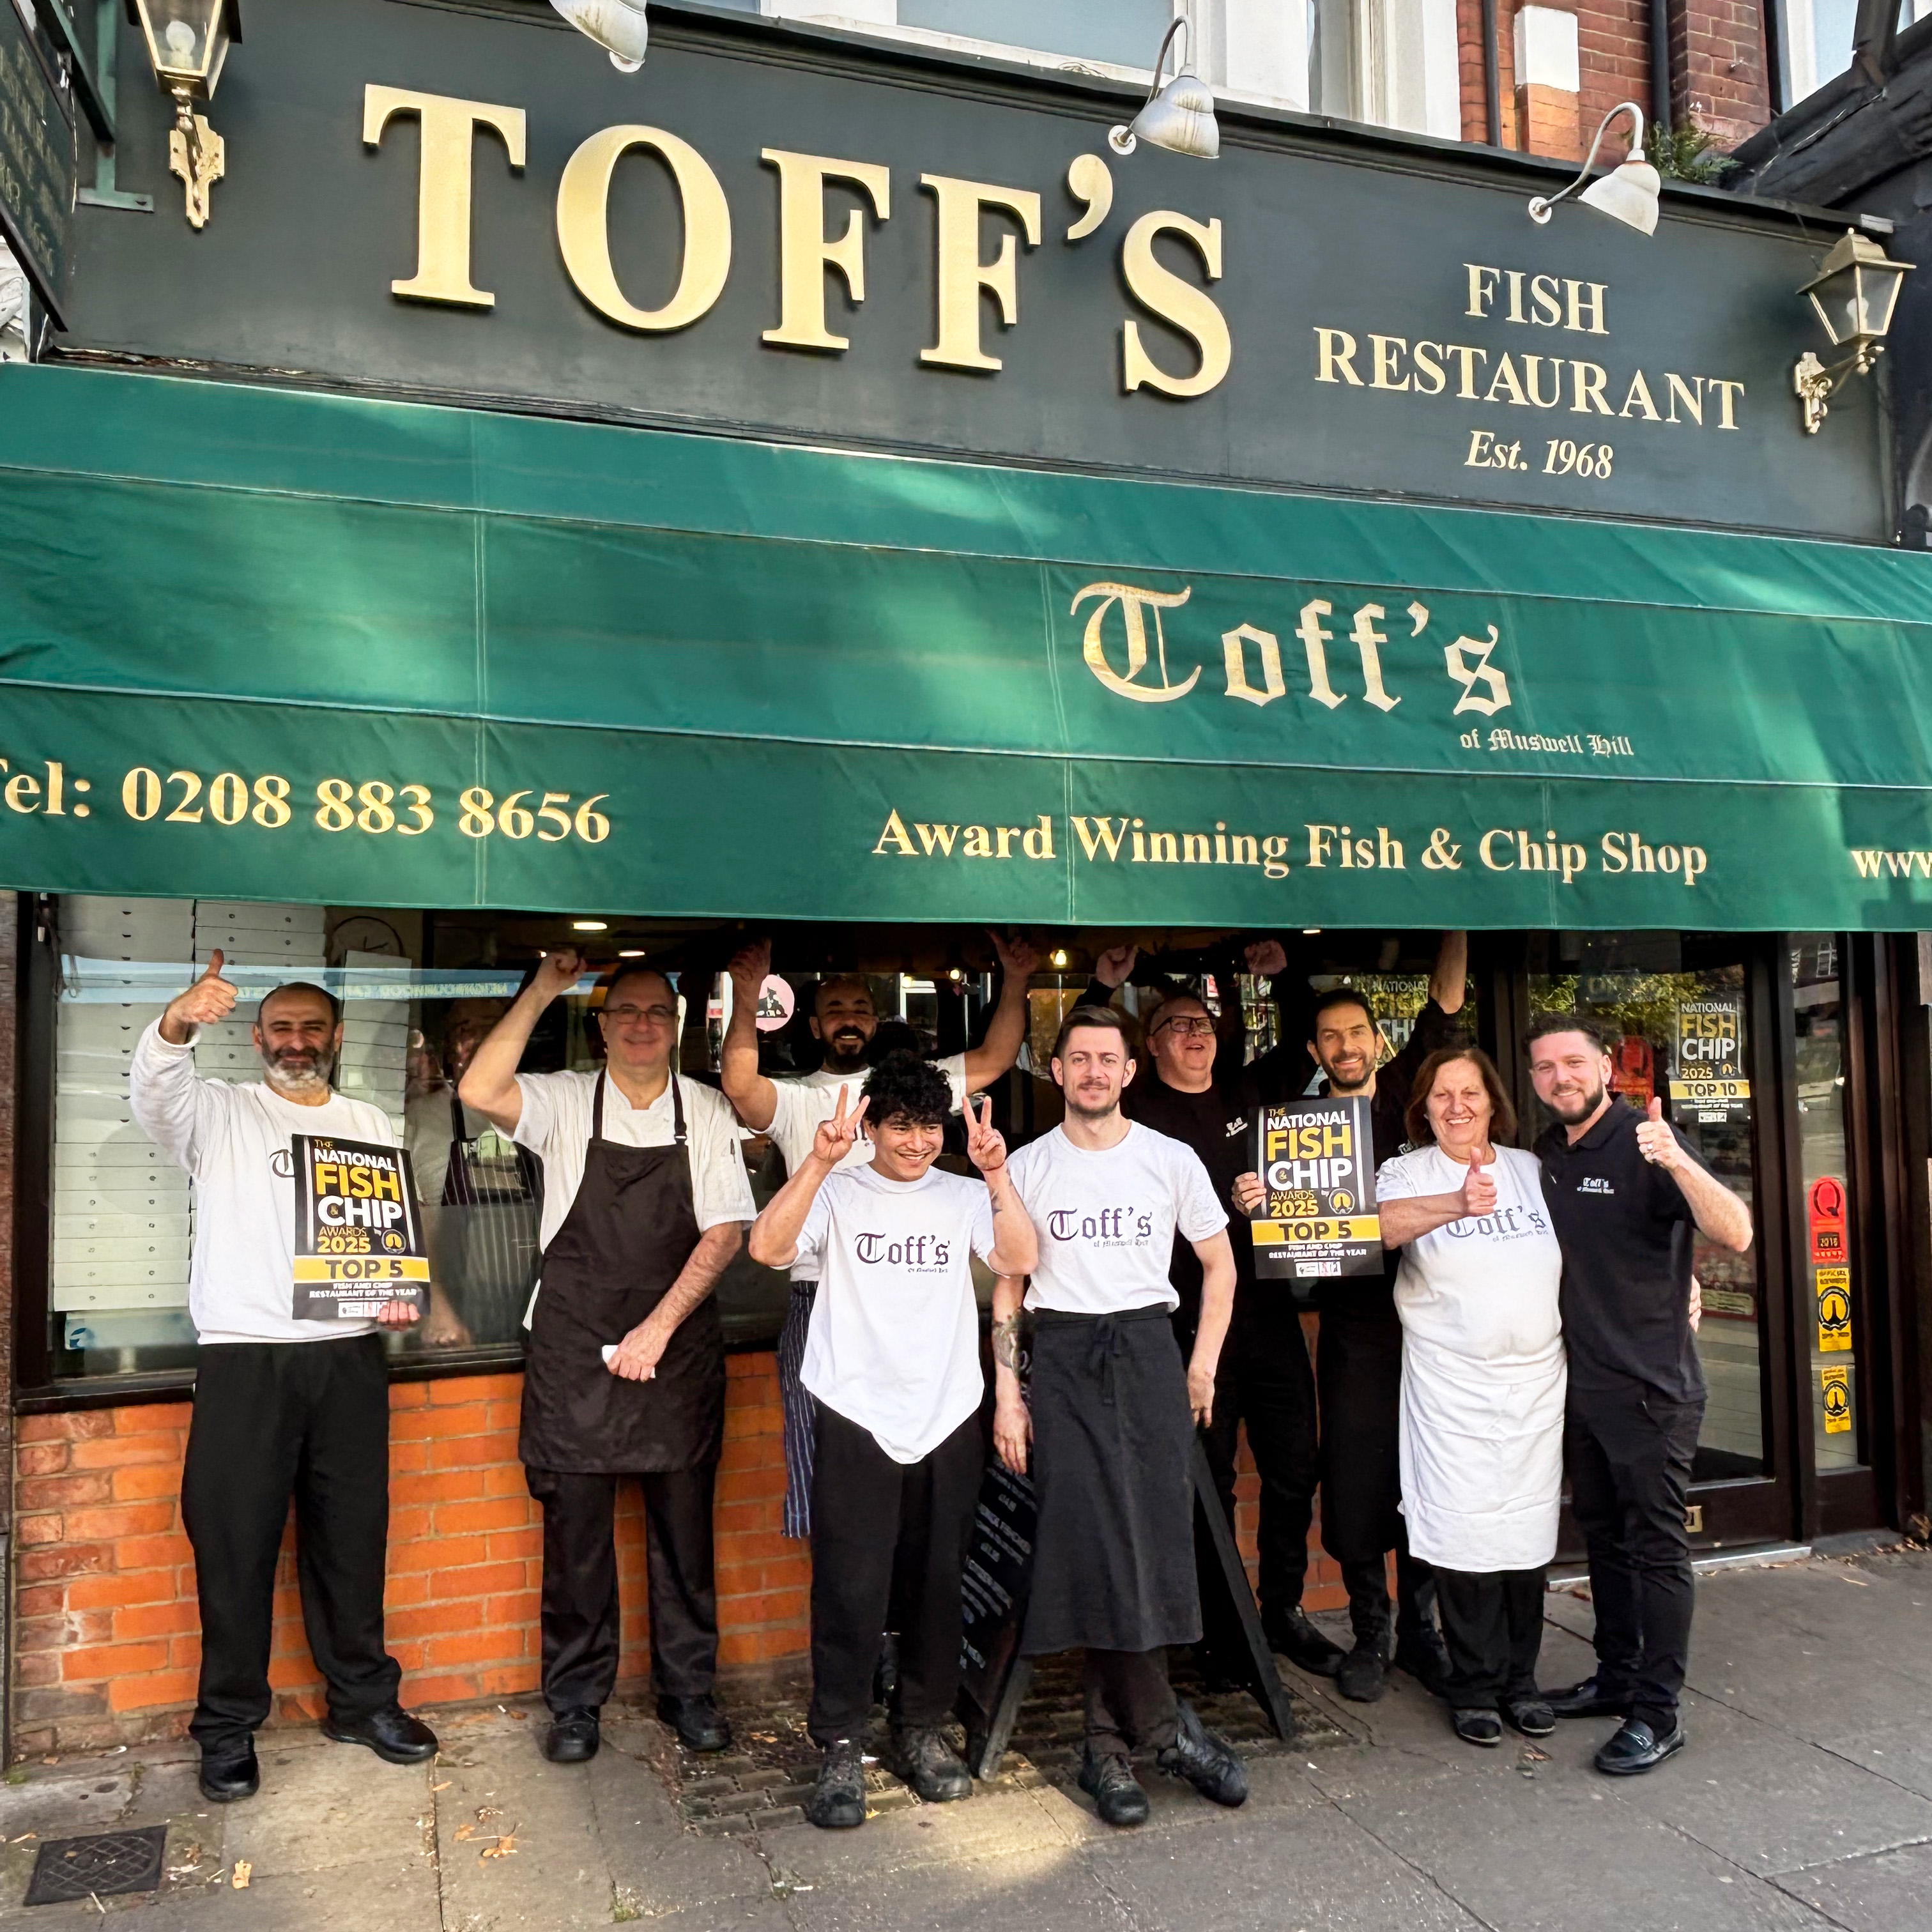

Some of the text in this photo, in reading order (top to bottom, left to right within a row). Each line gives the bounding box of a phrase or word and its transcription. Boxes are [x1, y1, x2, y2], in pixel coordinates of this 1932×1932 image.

[363, 84, 1232, 399] TOFF'S
[1463, 263, 1610, 335] FISH
[1313, 326, 1745, 430] RESTAURANT
[1465, 430, 1614, 479] Est. 1968
[1070, 581, 1512, 717] Toff's
[1460, 728, 1634, 758] of Muswell Hill
[0, 758, 611, 843] el: 0208 883 8656
[871, 809, 1708, 886] Award Winning Fish & Chip Shop
[1373, 981, 1429, 992] NATIONA
[1681, 1002, 1738, 1013] NATIONAL
[1681, 1013, 1736, 1038] FISH
[1682, 1038, 1736, 1061] CHIP
[1681, 1068, 1713, 1079] 2025
[1683, 1082, 1737, 1097] TOP 10
[1268, 1110, 1351, 1130] NATIONAL
[1269, 1107, 1286, 1117] THE
[314, 1139, 334, 1149] THE
[1268, 1125, 1352, 1161] FISH
[314, 1148, 396, 1171] NATIONAL
[316, 1163, 401, 1202] FISH
[1268, 1158, 1353, 1191] CHIP
[1271, 1190, 1314, 1201] AWARDS
[1813, 1181, 1841, 1218] Q
[318, 1195, 402, 1229] CHIP
[1270, 1200, 1319, 1217] 2025
[319, 1226, 367, 1238] AWARDS
[1047, 1206, 1153, 1241] Toff's
[1279, 1220, 1352, 1241] TOP 5
[317, 1236, 371, 1254] 2025
[854, 1232, 950, 1265] Toff's
[325, 1259, 404, 1278] TOP 5
